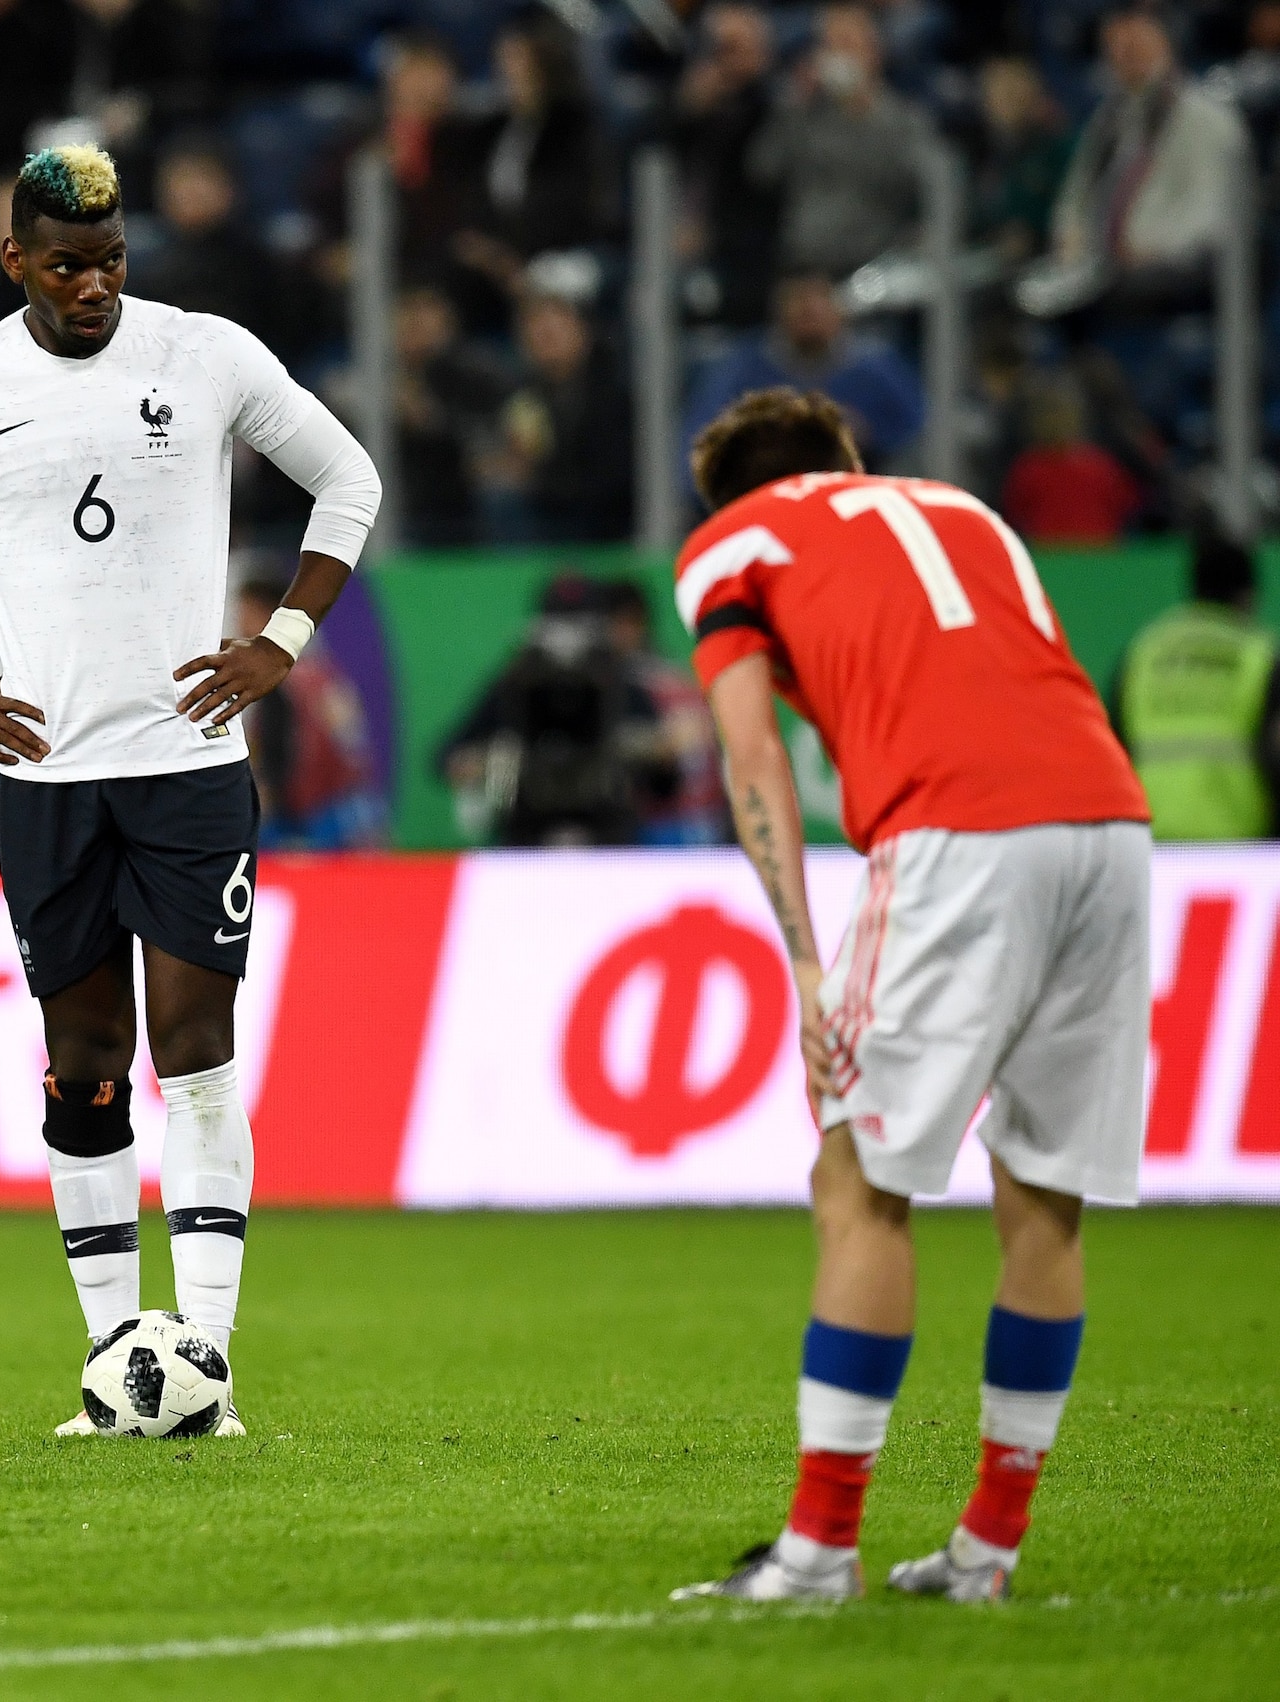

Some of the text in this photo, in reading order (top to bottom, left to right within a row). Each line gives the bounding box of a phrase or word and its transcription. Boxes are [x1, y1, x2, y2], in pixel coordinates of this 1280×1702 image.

[73, 474, 115, 543] 6
[827, 484, 1058, 645] 17
[222, 853, 252, 923] 6
